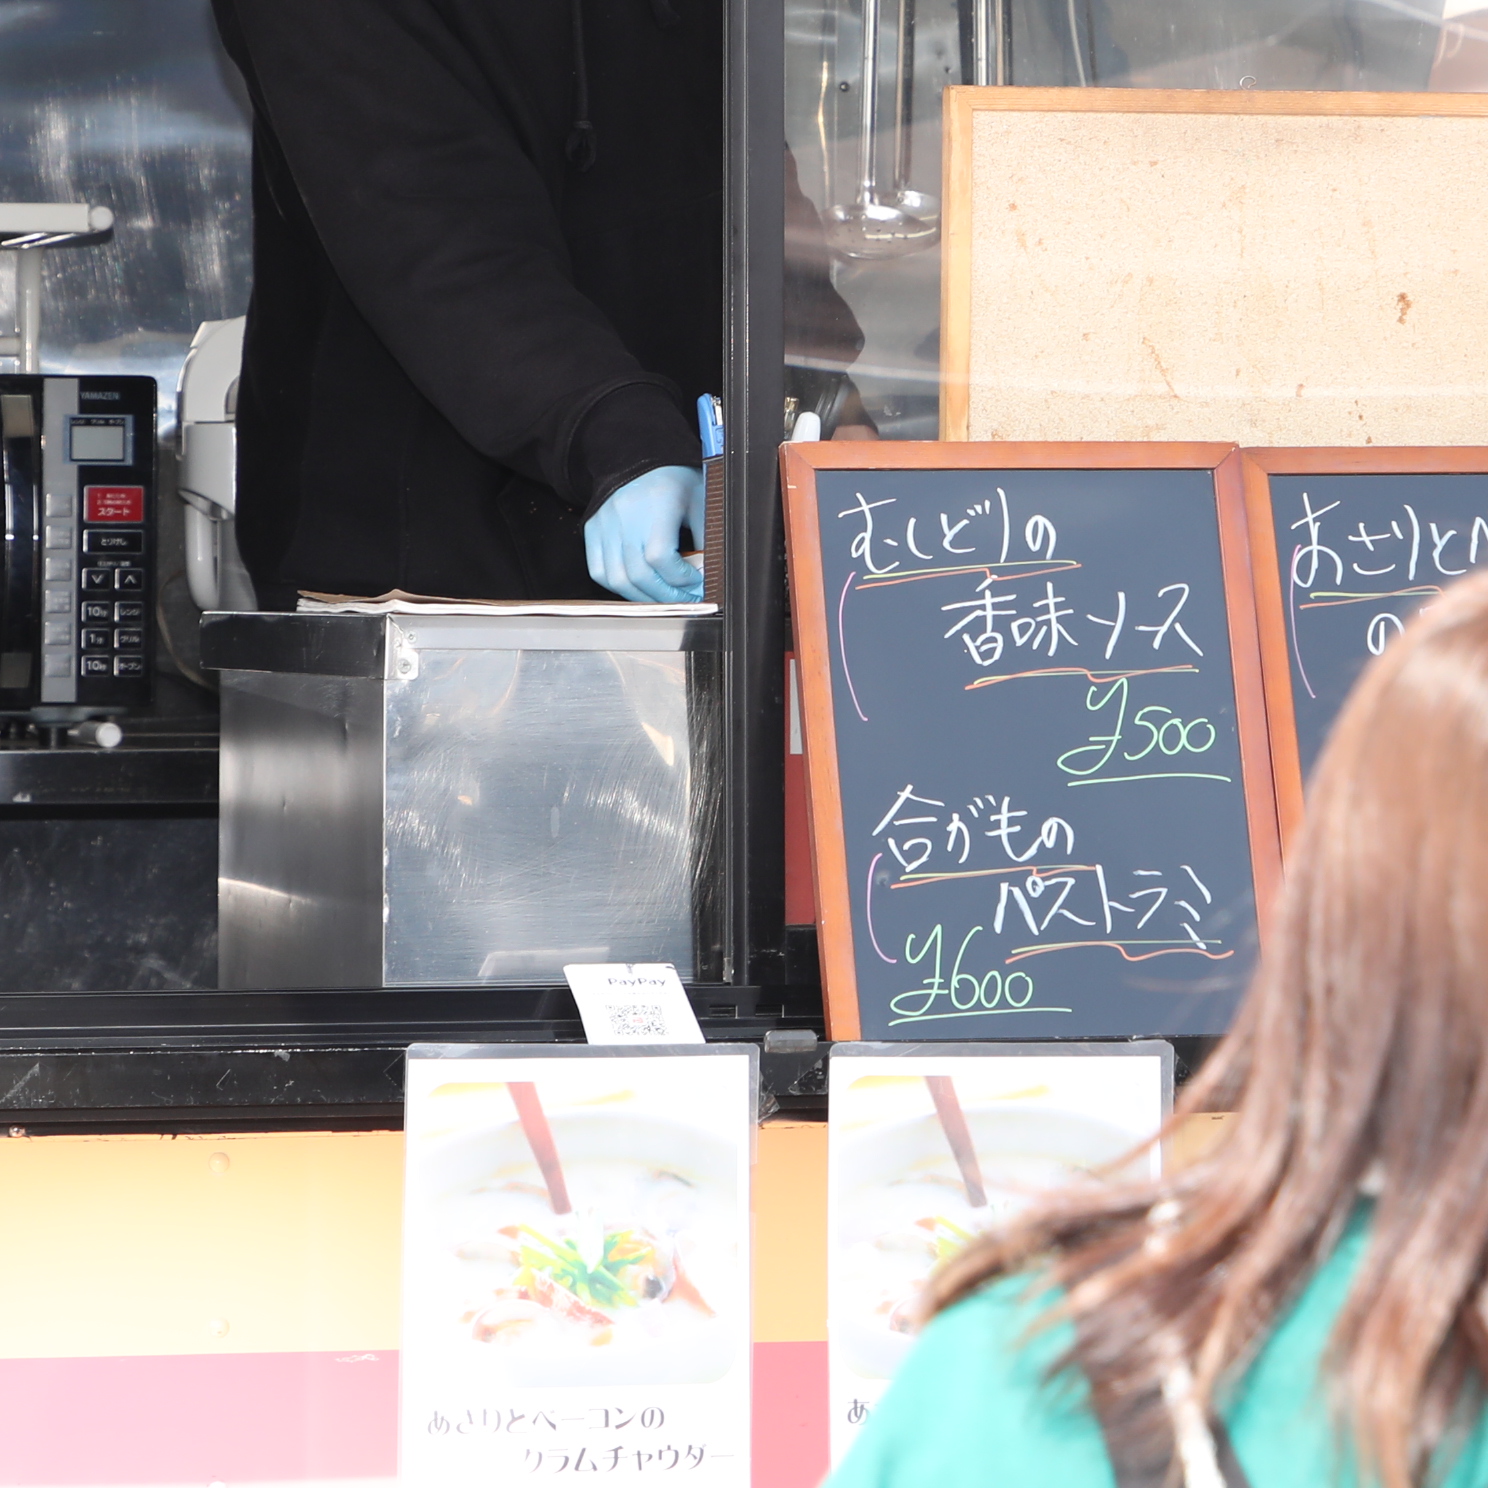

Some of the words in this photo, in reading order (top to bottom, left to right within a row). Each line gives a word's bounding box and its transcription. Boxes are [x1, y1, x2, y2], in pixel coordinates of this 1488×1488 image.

[80, 391, 120, 400] YAMAZEN
[943, 574, 1204, 667] 香味ソース
[873, 784, 1075, 871] 合がもの
[994, 864, 1214, 950] パストラミ
[608, 977, 666, 988] PayPay
[524, 1443, 735, 1474] クラムチャウダー
